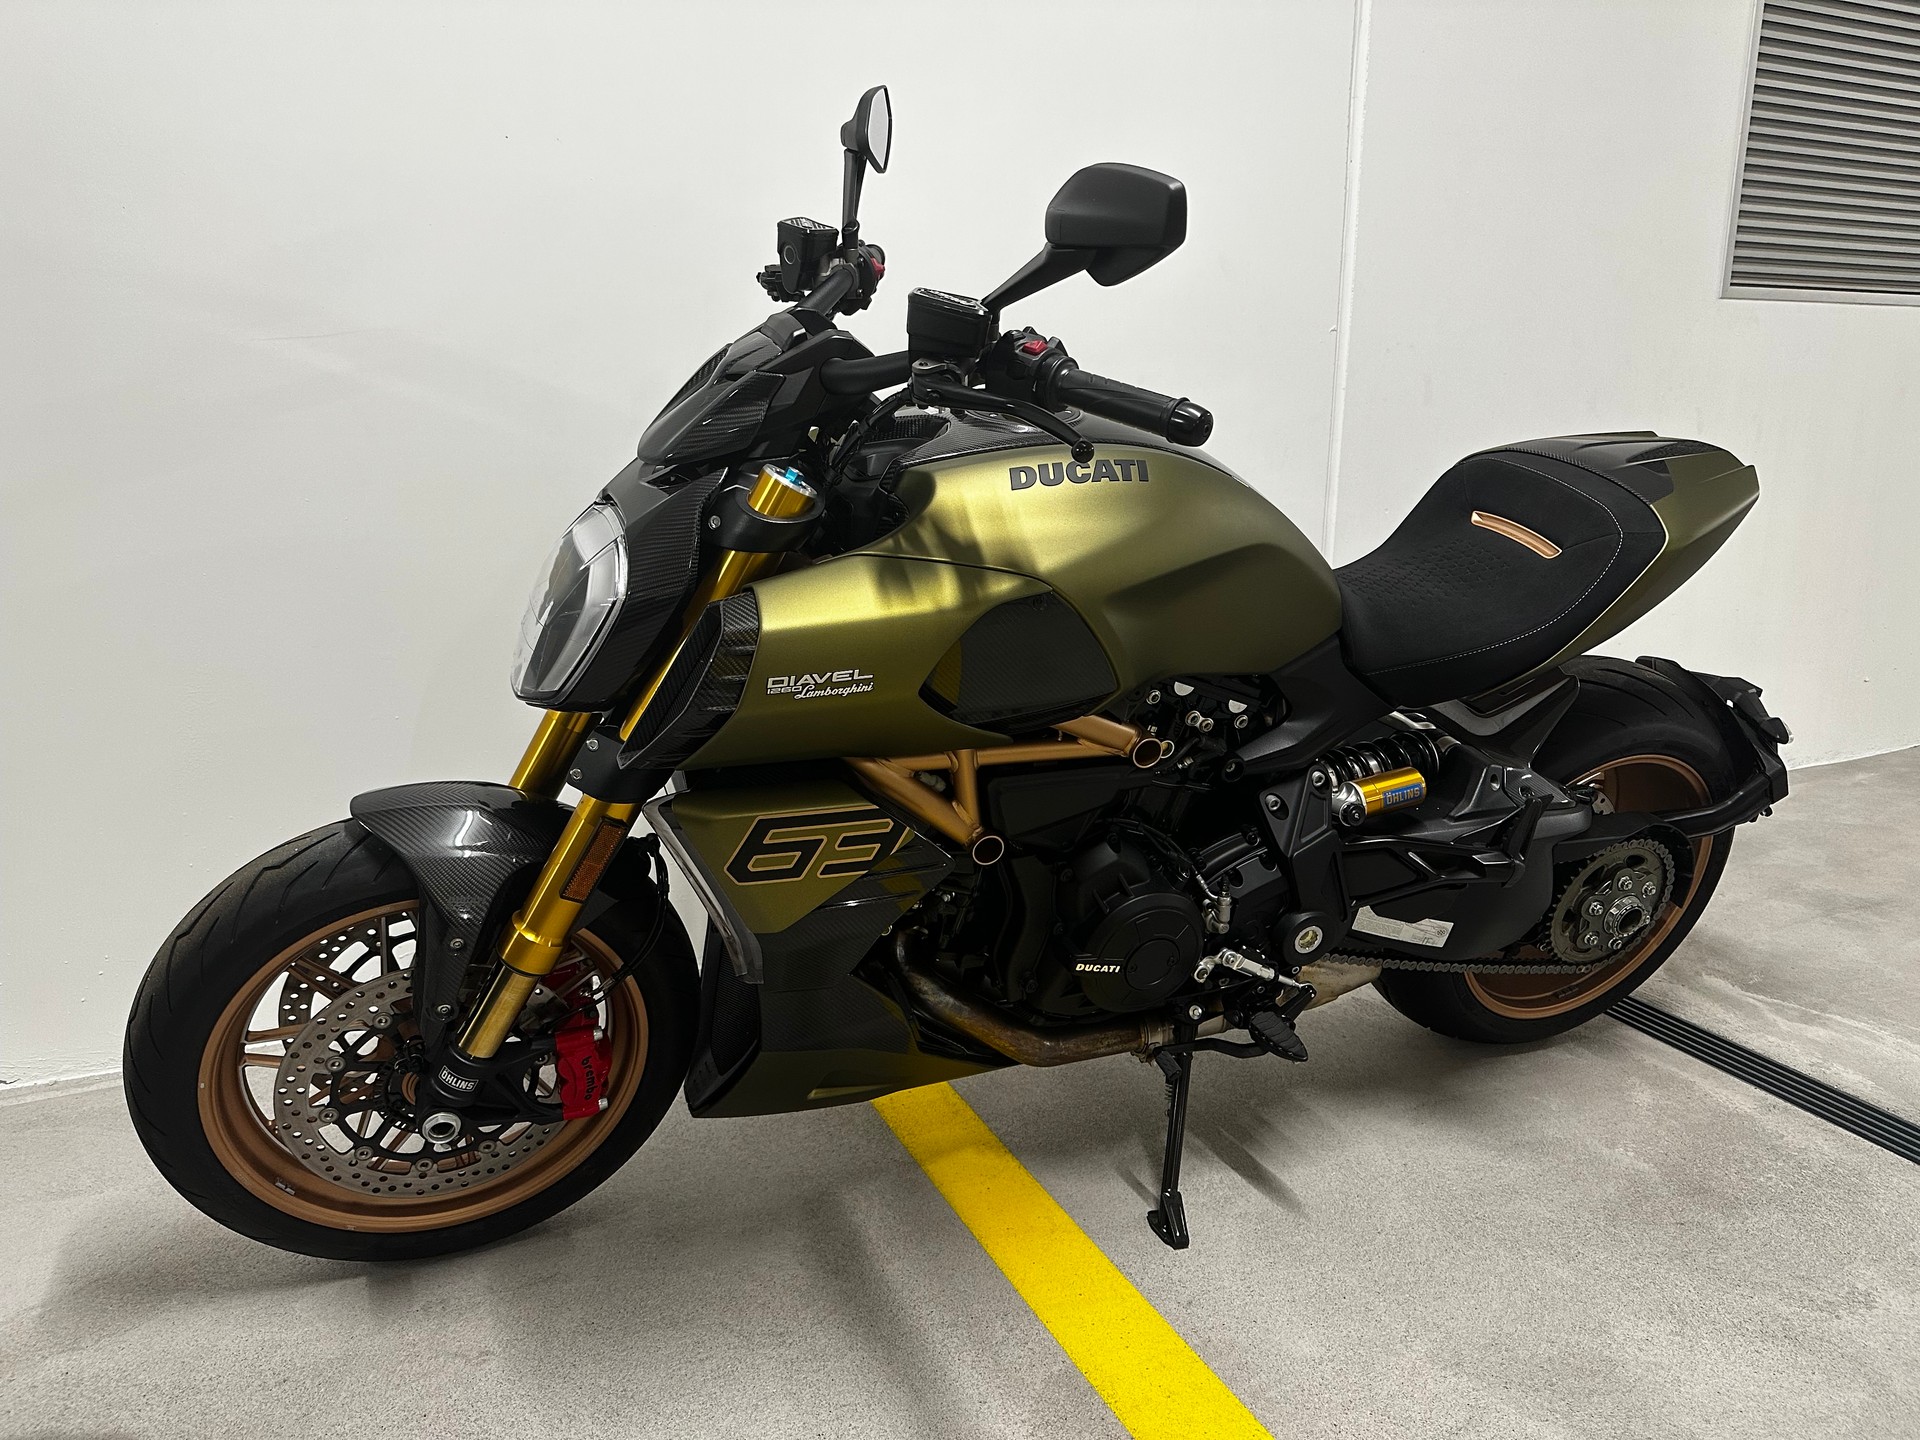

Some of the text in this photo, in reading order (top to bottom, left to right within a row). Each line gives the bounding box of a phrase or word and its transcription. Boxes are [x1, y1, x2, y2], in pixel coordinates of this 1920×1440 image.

[1009, 459, 1149, 491] DUCATI
[767, 669, 874, 688] DIAVEL
[767, 682, 874, 699] 1260 Lamborghini
[1386, 787, 1420, 805] ÖHLINS
[724, 804, 910, 886] 63
[1075, 963, 1121, 973] DUCATI
[581, 1055, 599, 1100] brembo
